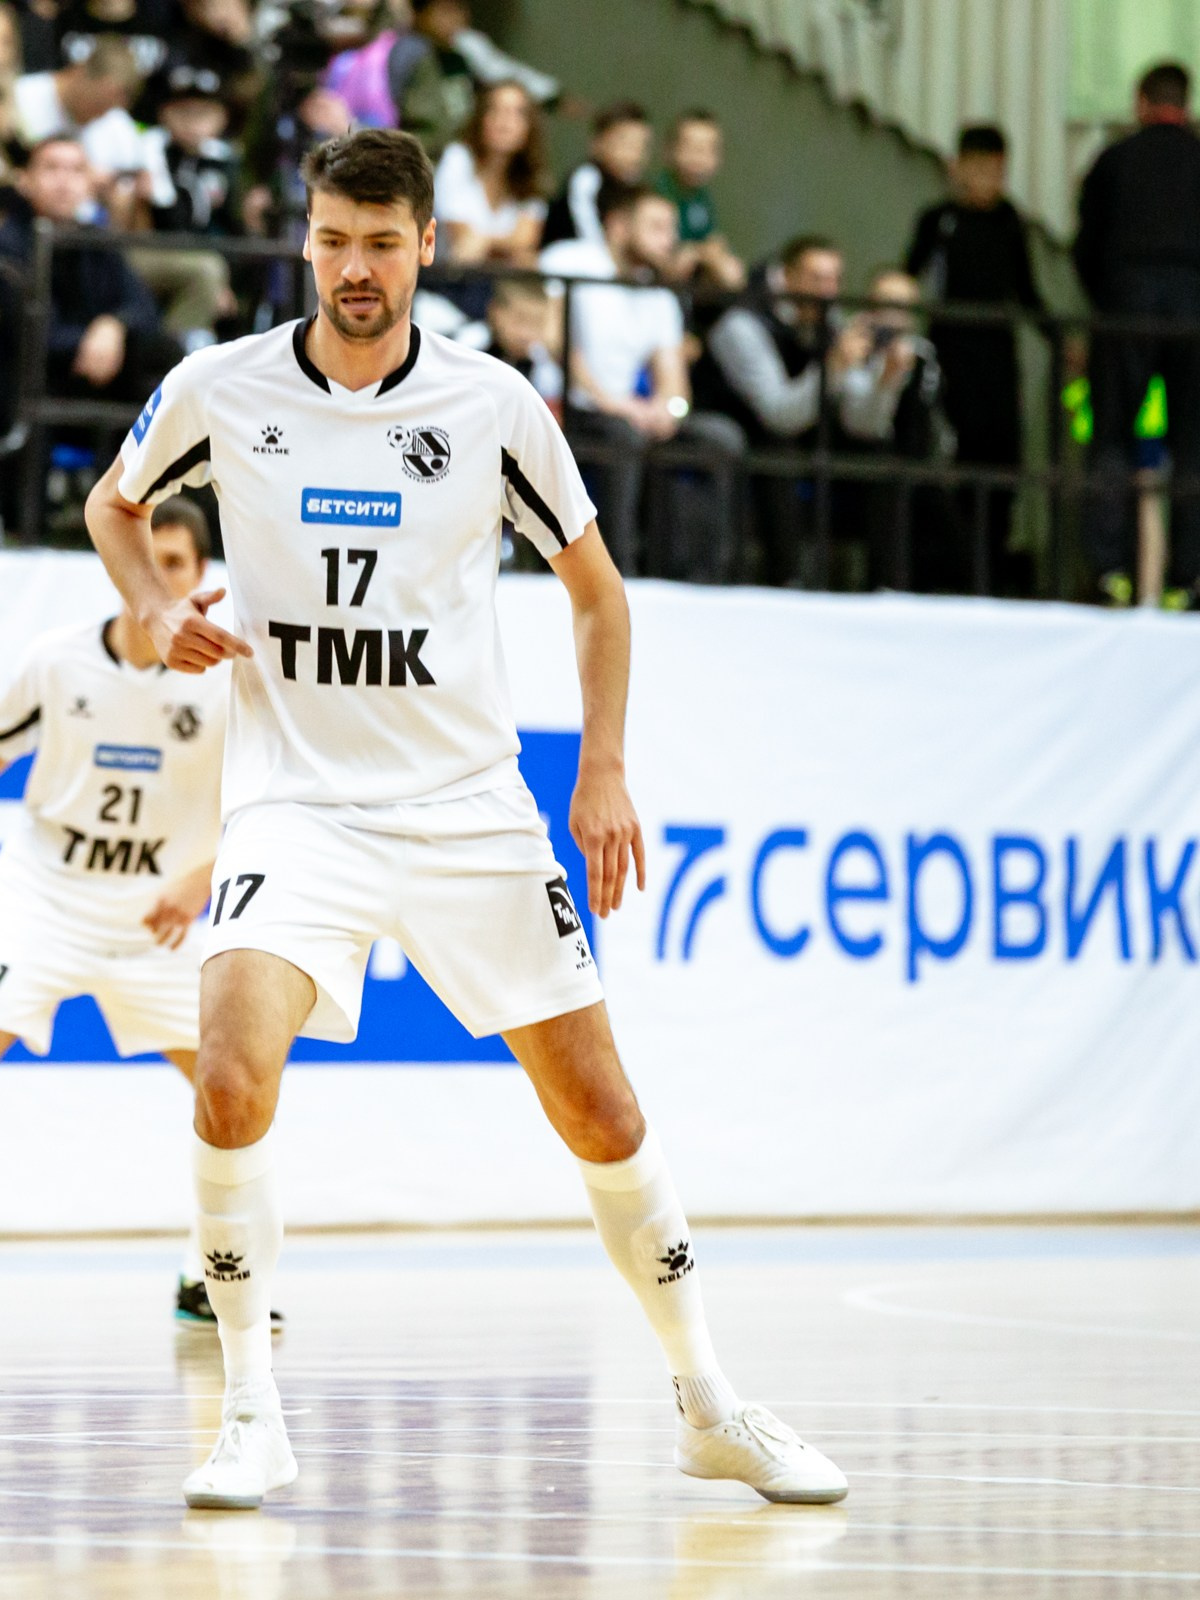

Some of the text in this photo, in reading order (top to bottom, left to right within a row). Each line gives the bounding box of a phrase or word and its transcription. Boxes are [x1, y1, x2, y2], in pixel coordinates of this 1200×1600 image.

[253, 446, 289, 455] KELME
[306, 498, 397, 517] БЕТСИТИ
[321, 548, 378, 607] 17
[98, 783, 142, 826] 21
[212, 873, 266, 927] 17
[749, 825, 1198, 983] сервик
[205, 1269, 250, 1281] KELME
